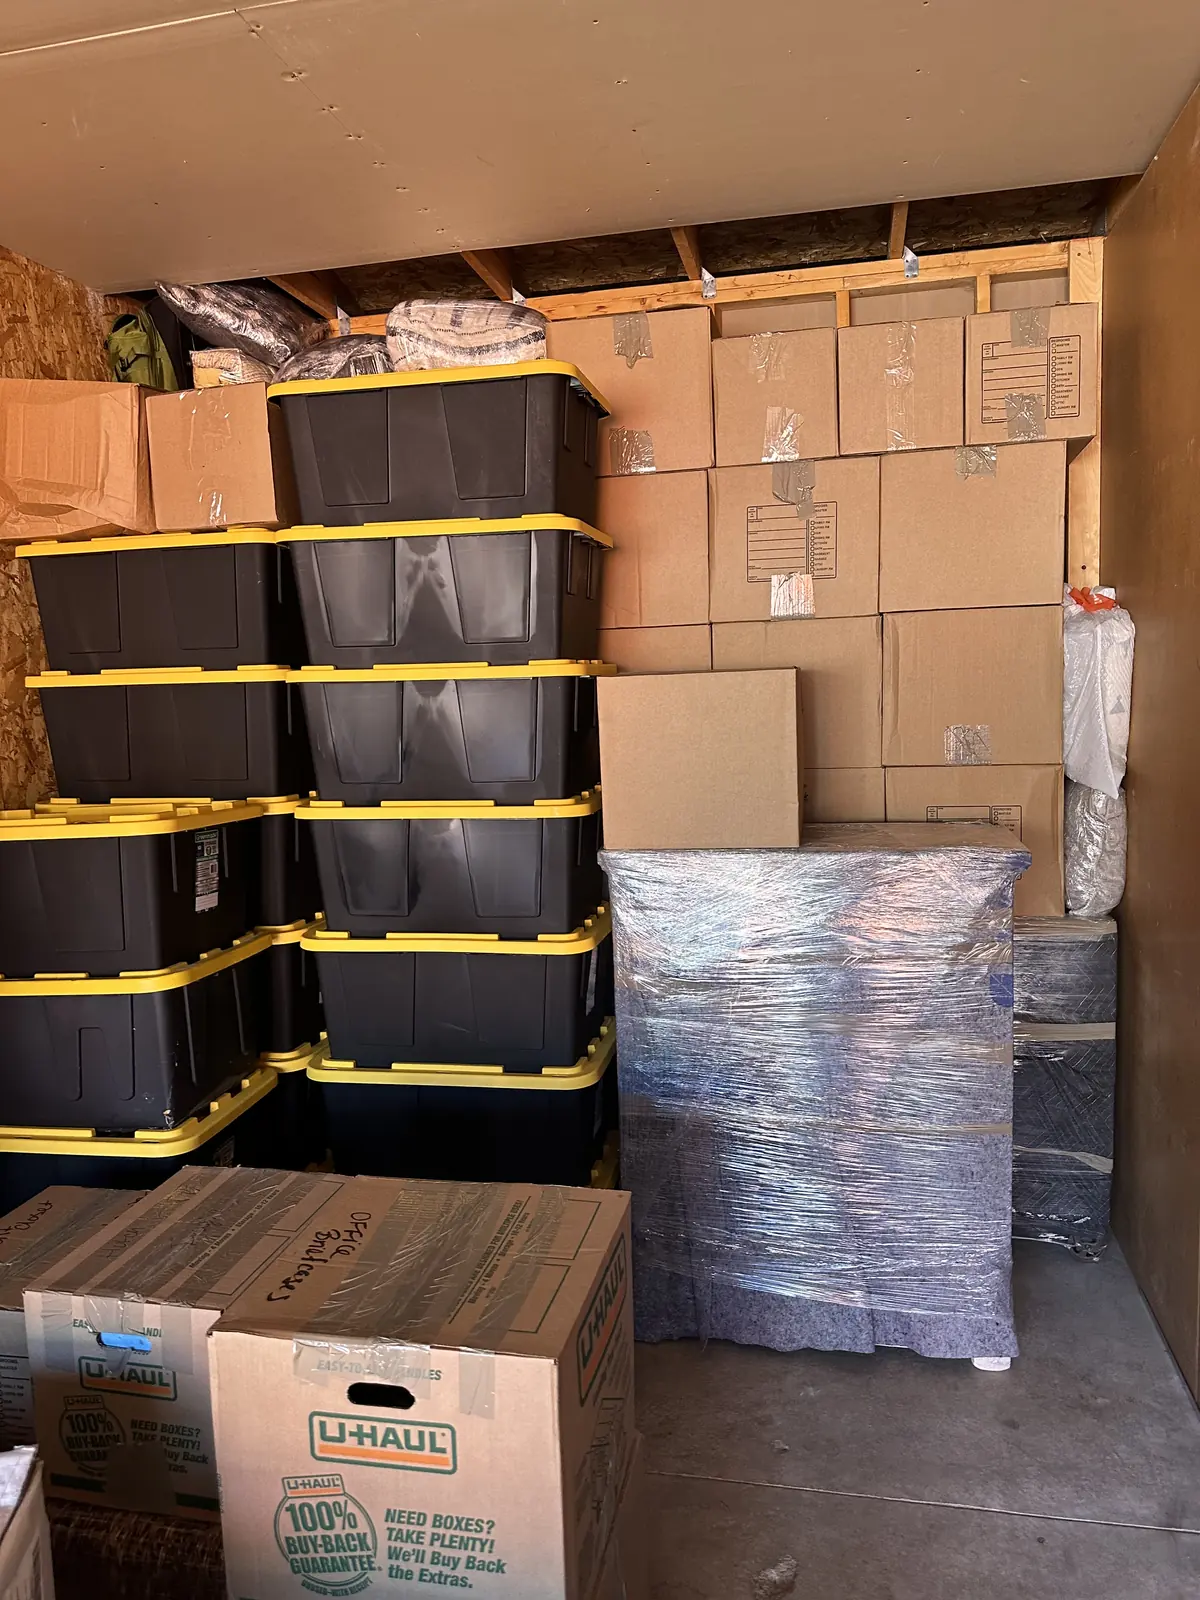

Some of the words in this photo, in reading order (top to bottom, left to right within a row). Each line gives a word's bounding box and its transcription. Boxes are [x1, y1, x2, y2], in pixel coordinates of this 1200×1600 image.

[66, 1412, 114, 1433] 100%
[130, 1418, 158, 1431] NEED
[160, 1422, 201, 1438] BOXES?
[319, 1420, 448, 1454] U-HAUL
[182, 1451, 208, 1465] Back
[285, 1499, 358, 1532] 100%
[384, 1508, 427, 1526] NEED
[431, 1513, 496, 1535] BOXES?
[285, 1532, 371, 1555] BUY-BACK
[386, 1527, 425, 1545] TAKE
[429, 1532, 496, 1554] PLENTY!
[387, 1545, 425, 1564] We'll
[430, 1551, 461, 1571] Buy
[465, 1555, 507, 1575] Back
[388, 1564, 414, 1581] the
[418, 1568, 473, 1589] Extras.
